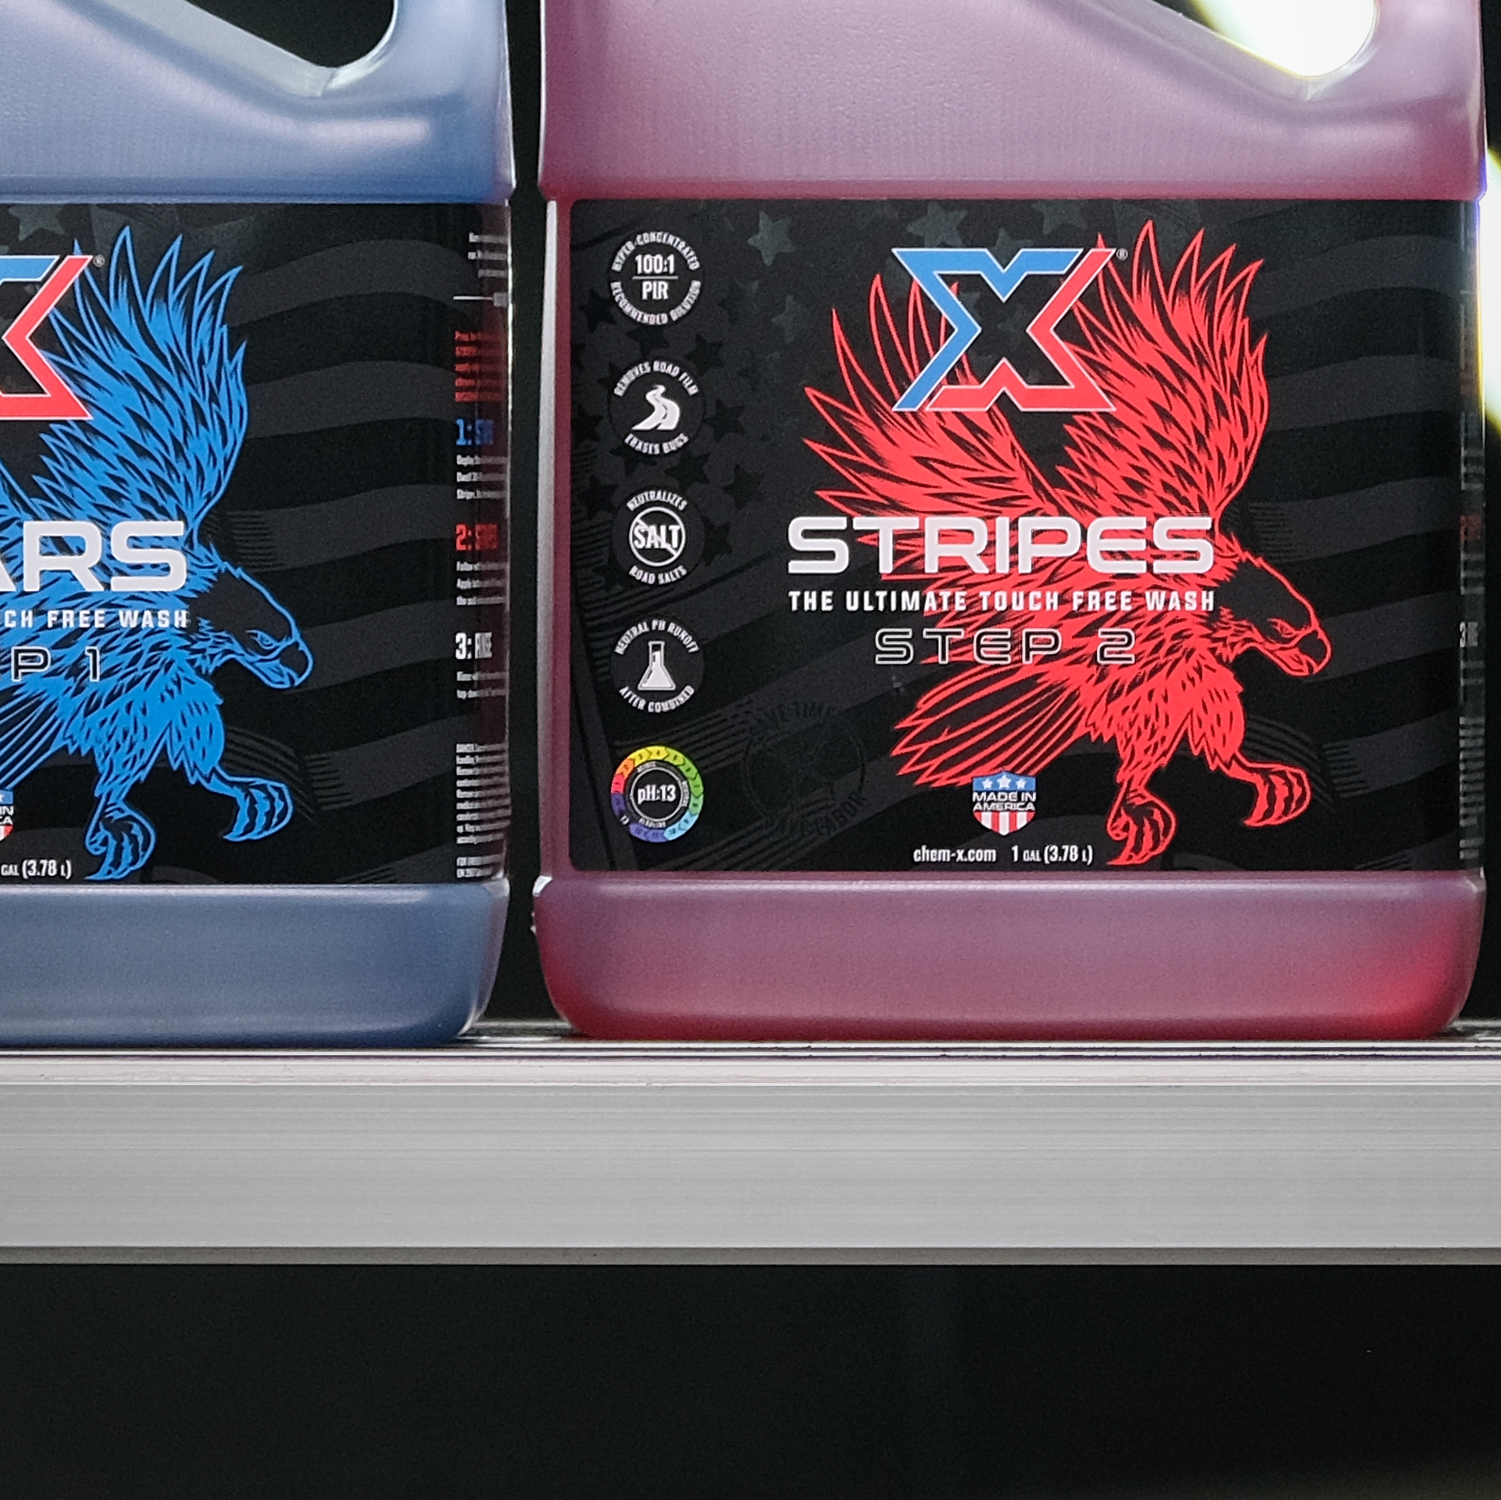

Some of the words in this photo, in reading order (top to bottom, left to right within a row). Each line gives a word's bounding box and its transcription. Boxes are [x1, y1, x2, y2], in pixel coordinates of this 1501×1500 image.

[634, 254, 675, 275] 100:1
[642, 281, 668, 300] PIR
[613, 361, 651, 397] REMOVES
[653, 360, 680, 377] ROAD
[679, 371, 699, 396] FILM
[633, 524, 680, 549] SALT
[787, 516, 1214, 574] STRIPES
[629, 565, 655, 585] ROAD
[658, 565, 687, 585] SALTS
[788, 591, 833, 611] THE
[846, 591, 967, 611] ULTIMATE
[980, 591, 1059, 611] TOUCH
[1072, 591, 1132, 611] FREE
[1145, 591, 1215, 611] WASH
[47, 609, 106, 628] FREE
[118, 609, 188, 628] WASH
[875, 628, 1062, 665] STEP
[1097, 628, 1135, 665] 2
[85, 646, 100, 682] 1
[619, 686, 645, 711] AFTER
[637, 784, 676, 805] pH:13
[972, 792, 1018, 802] MADE
[1021, 792, 1037, 802] IN
[0, 806, 14, 815] IN
[972, 802, 1036, 811] AMERICA
[913, 845, 996, 862] chem-x.com
[1011, 845, 1019, 862] 1
[1044, 845, 1078, 865] (3.78
[22, 859, 57, 880] (3.78
